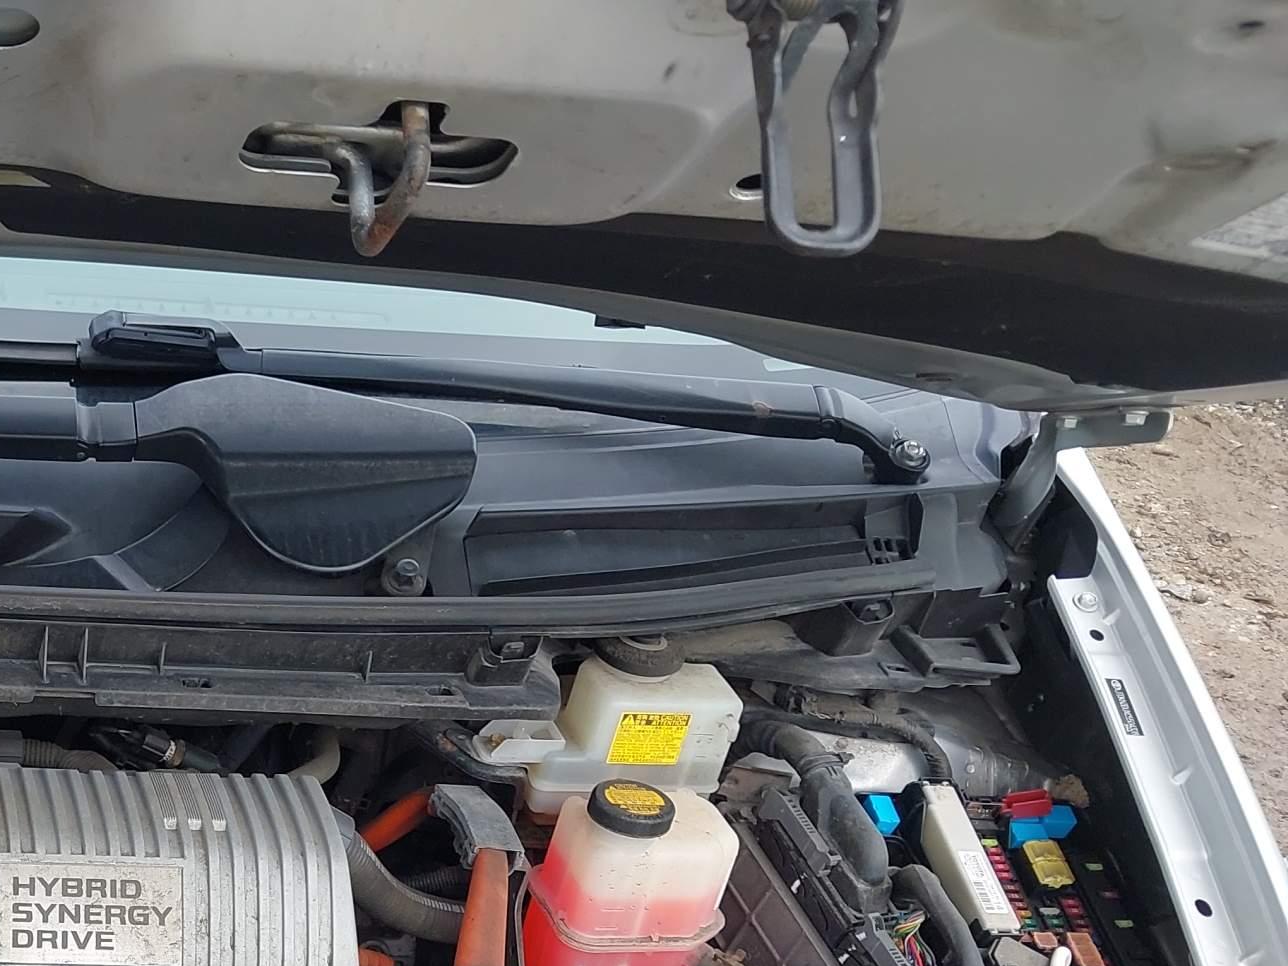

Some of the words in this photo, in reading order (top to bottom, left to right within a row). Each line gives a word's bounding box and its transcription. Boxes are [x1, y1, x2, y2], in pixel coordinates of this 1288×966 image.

[12, 876, 142, 900] HYBRID
[11, 902, 173, 927] SYNERGY
[12, 929, 114, 952] DRIVE
